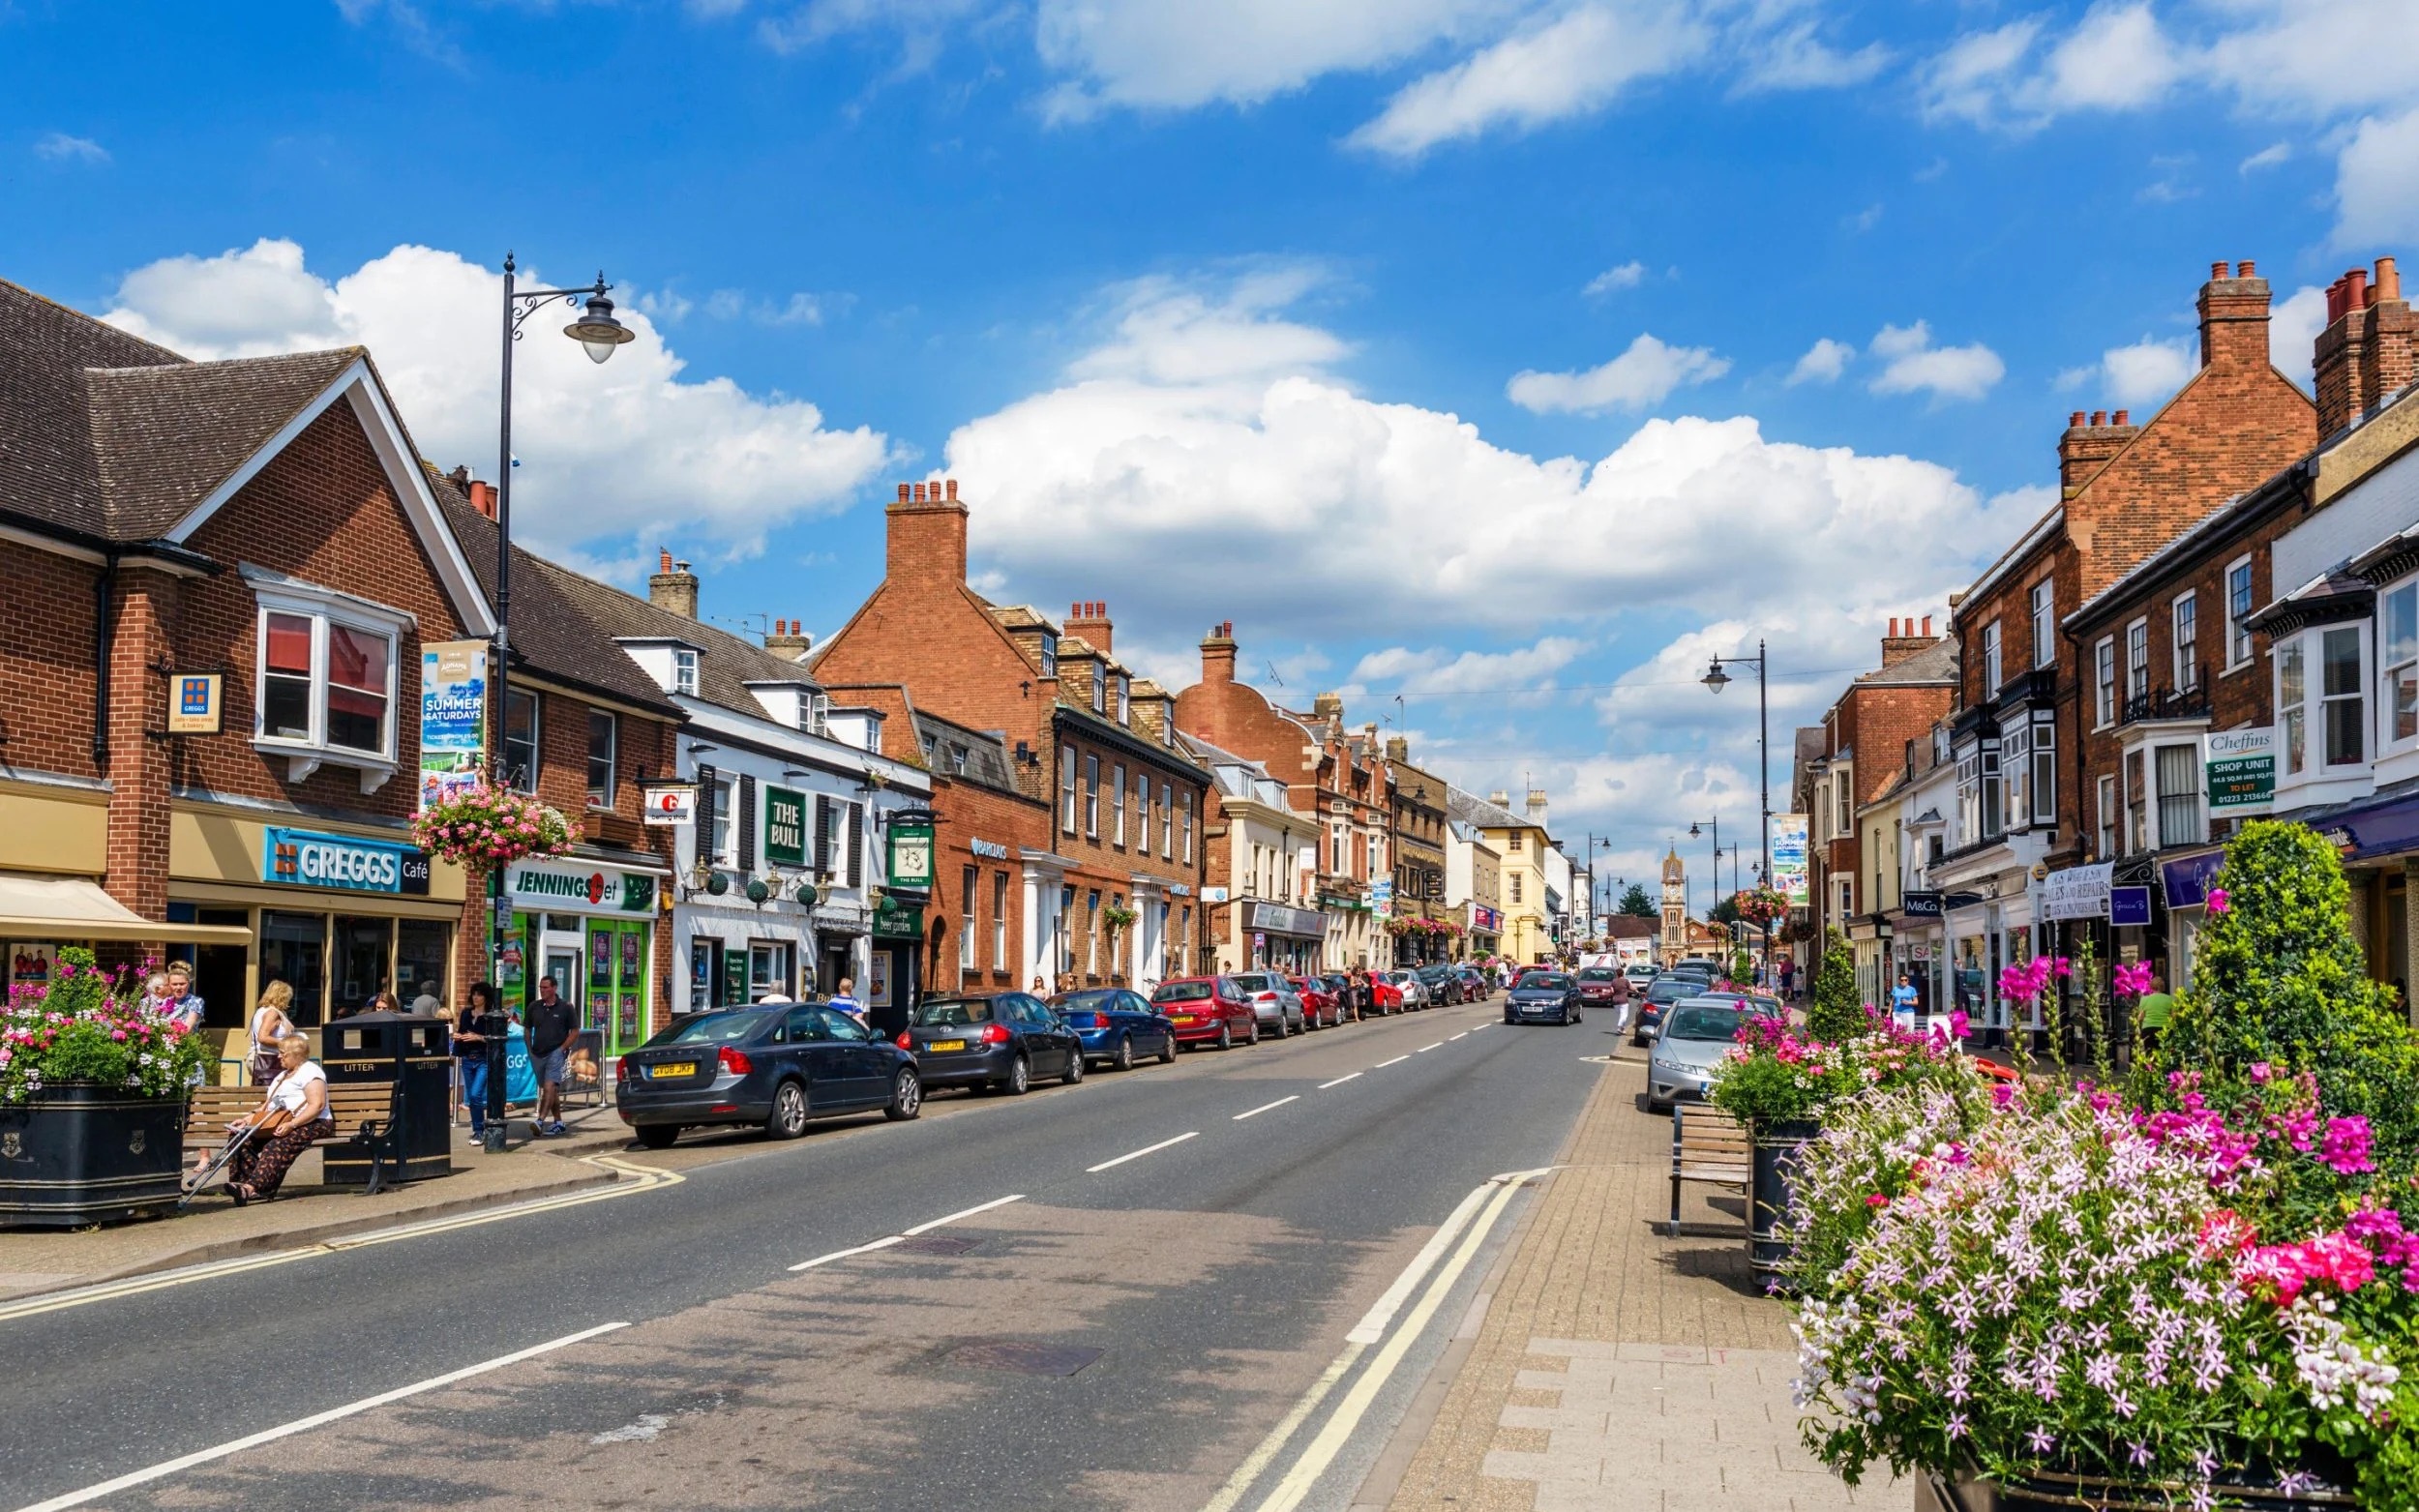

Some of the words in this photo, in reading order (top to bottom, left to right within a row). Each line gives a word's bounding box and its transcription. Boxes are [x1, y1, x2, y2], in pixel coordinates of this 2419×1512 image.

[426, 698, 482, 711] SUMMER
[425, 710, 482, 721] SATURDAYS
[2210, 732, 2271, 752] Cheffins
[2214, 761, 2243, 773] SHOP
[2245, 758, 2271, 770] UNIT
[2218, 794, 2241, 804] 01223
[771, 801, 799, 826] THE
[769, 823, 801, 848] BULL
[978, 839, 1007, 860] BARCLAYS
[301, 844, 396, 885] GREGGS
[403, 862, 428, 879] Café
[2077, 881, 2109, 899] REPAIRS
[880, 915, 892, 930] beer
[892, 919, 911, 934] garden
[343, 1063, 374, 1072] LITTER
[417, 1061, 438, 1070] LITTER
